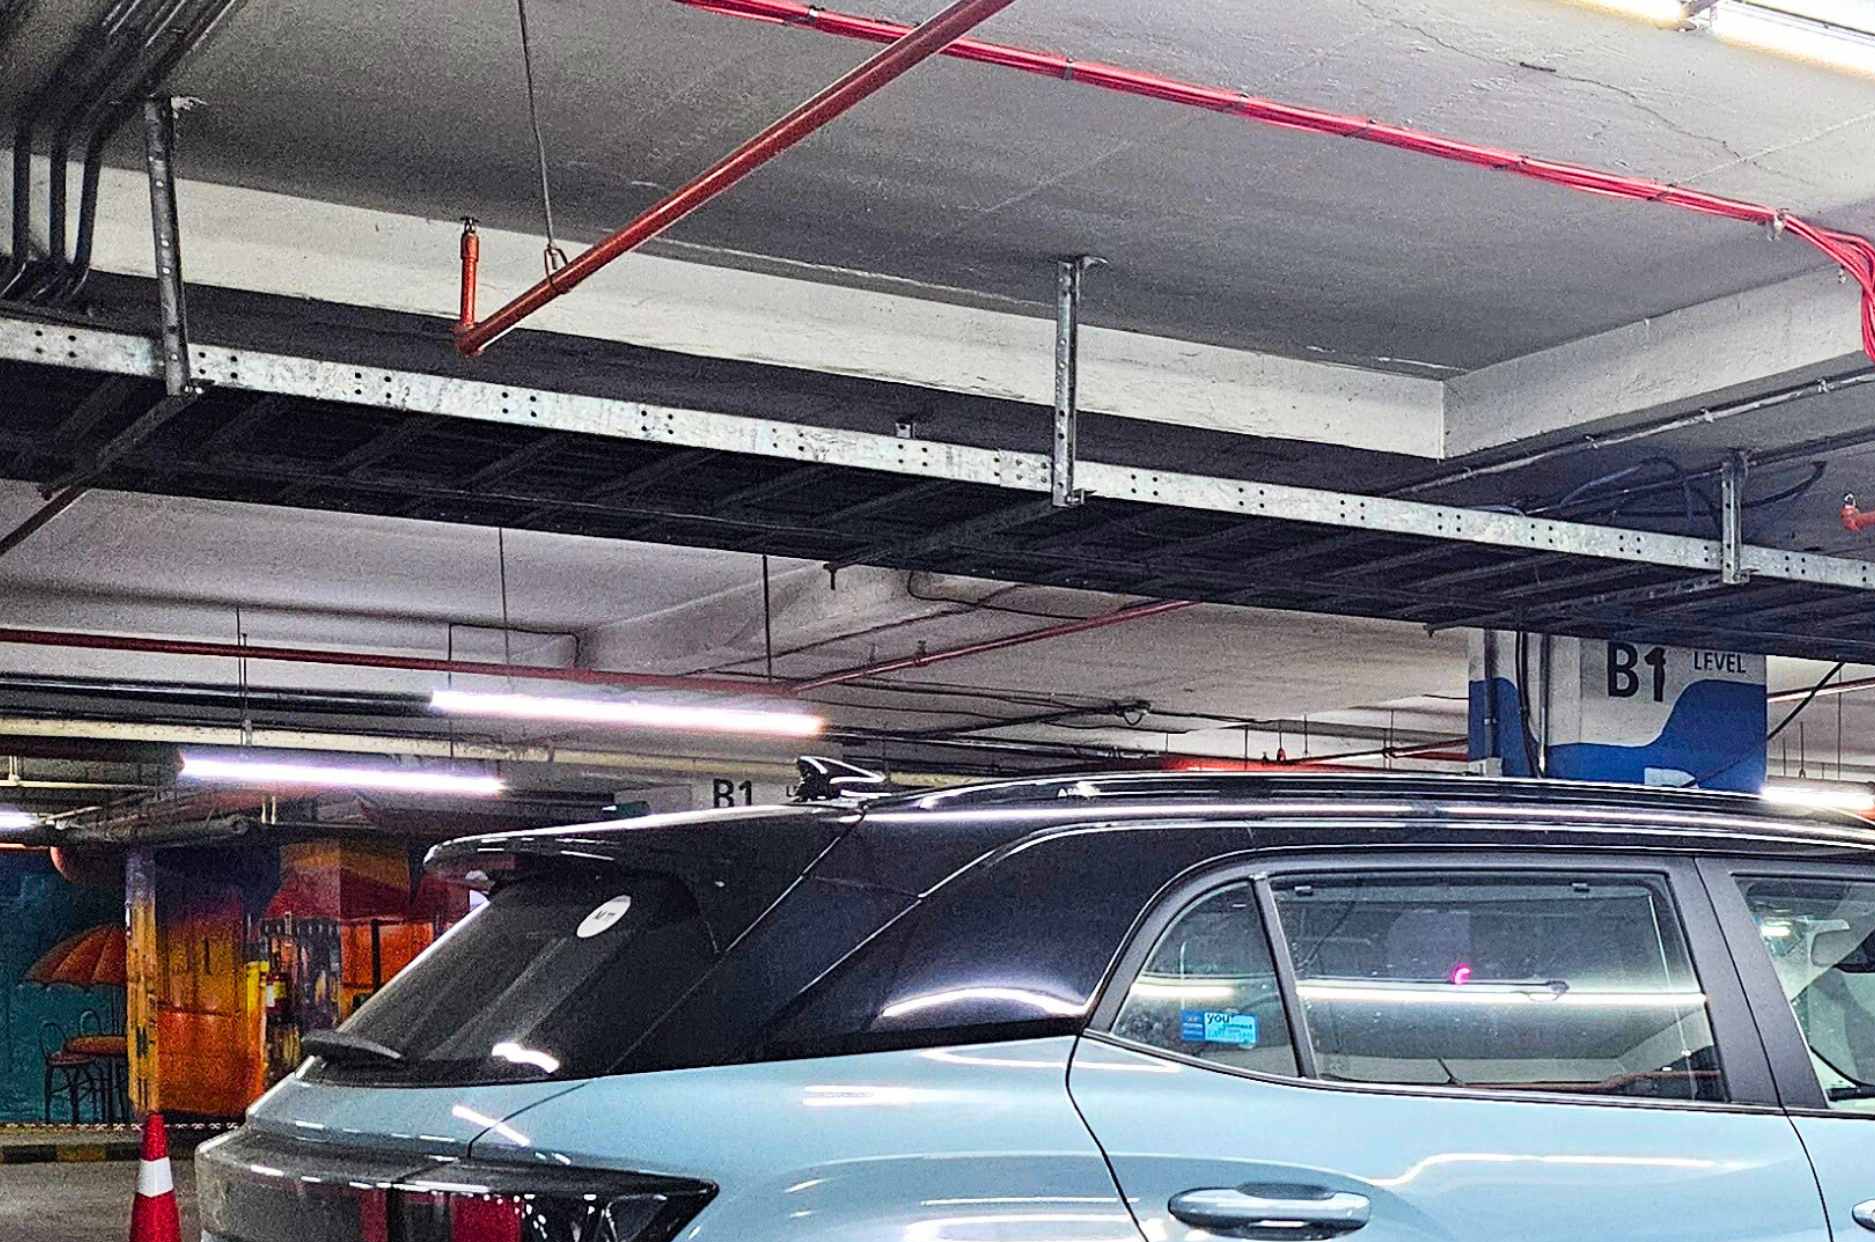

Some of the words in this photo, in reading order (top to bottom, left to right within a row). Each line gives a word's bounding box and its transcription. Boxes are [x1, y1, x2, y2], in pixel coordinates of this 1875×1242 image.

[1607, 640, 1667, 702] B1
[1694, 651, 1747, 673] LEVEL
[713, 778, 752, 808] B1
